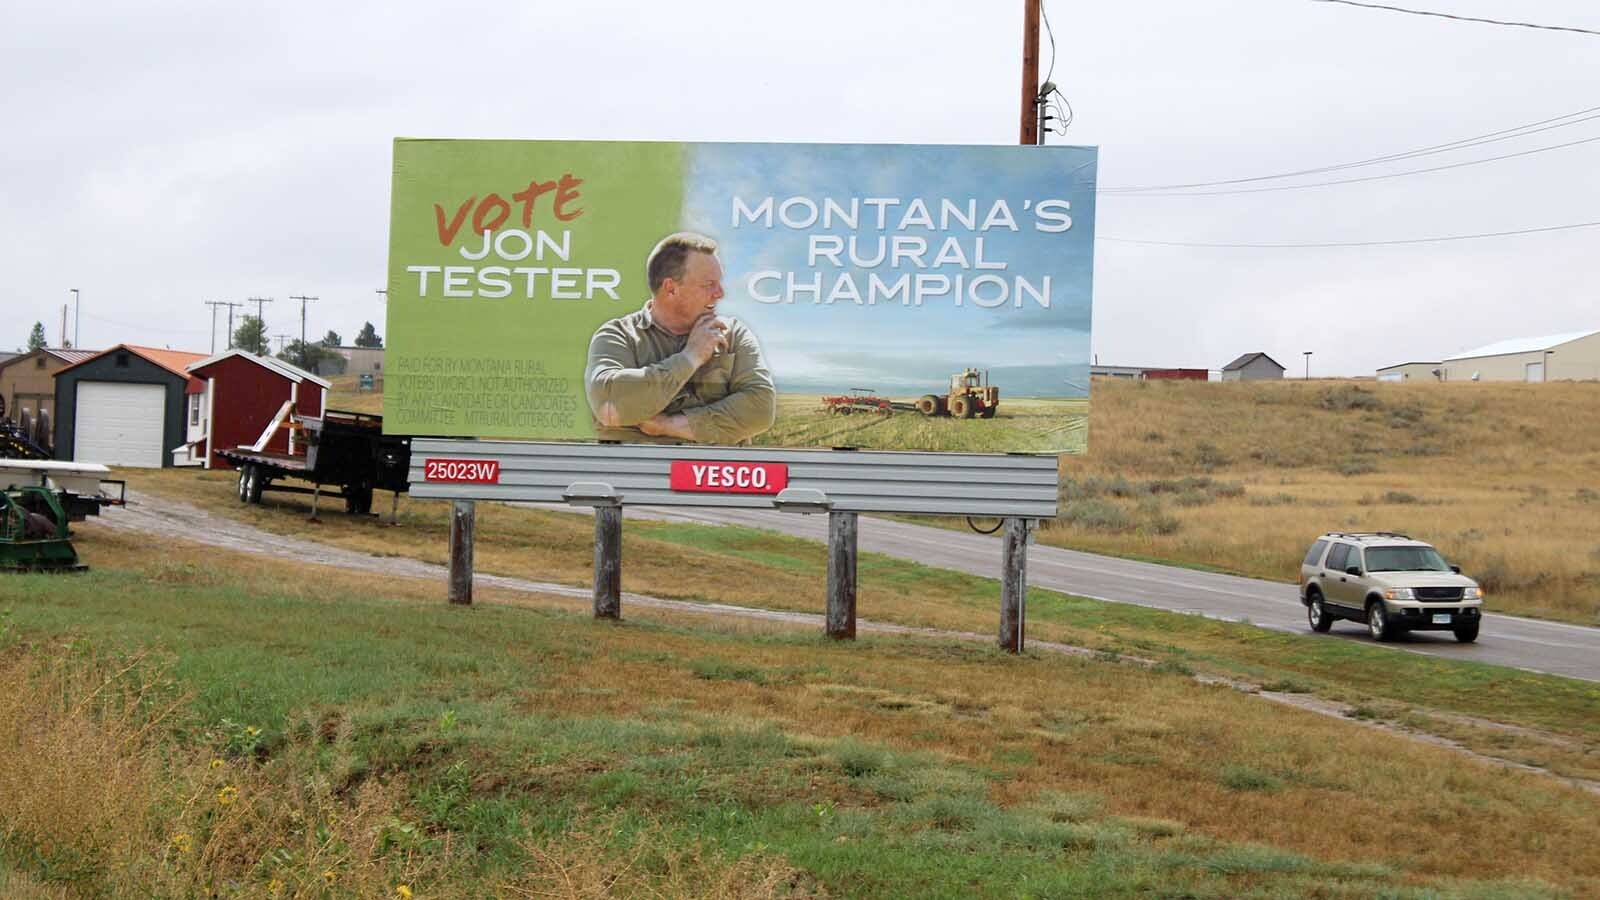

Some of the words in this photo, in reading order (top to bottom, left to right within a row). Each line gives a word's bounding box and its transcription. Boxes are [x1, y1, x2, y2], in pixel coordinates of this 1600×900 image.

[434, 174, 584, 247] VOTE
[731, 196, 1073, 233] MONTANA'S
[459, 229, 571, 261] JON
[807, 235, 1008, 270] RURAL
[407, 265, 622, 300] TESTER
[748, 271, 1052, 308] CHAMPION
[398, 357, 421, 373] PAID
[423, 358, 442, 374] FOR
[460, 359, 512, 375] MONTANA
[515, 360, 546, 375] RURAL
[480, 377, 501, 392] NOT
[503, 377, 568, 393] AUTHORIZED
[427, 462, 495, 480] 25023W
